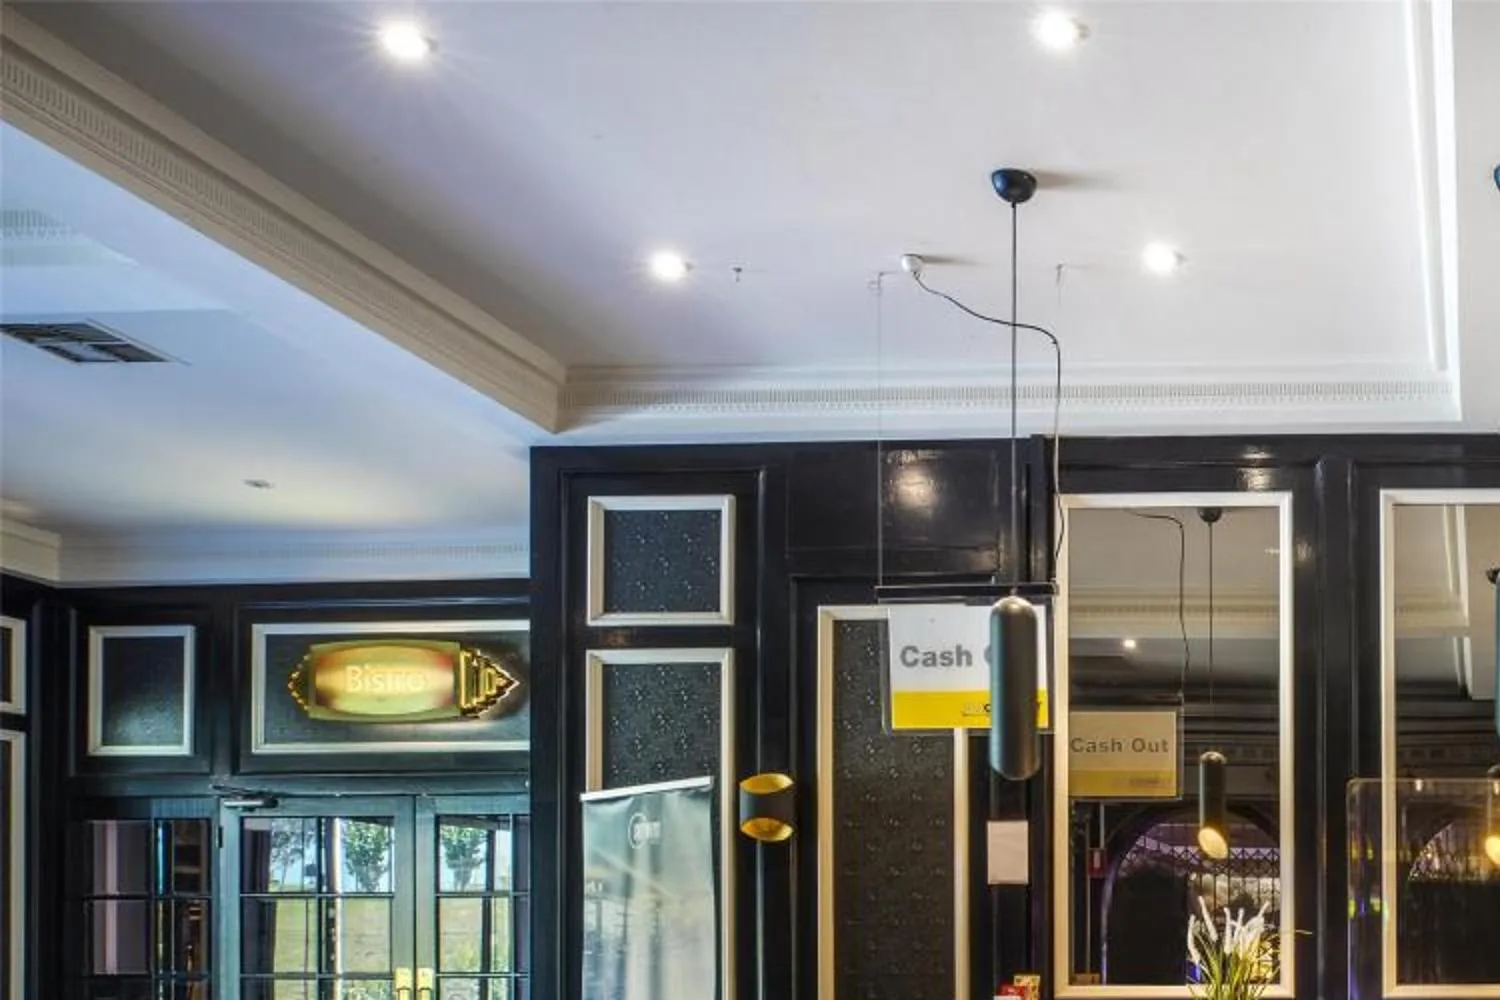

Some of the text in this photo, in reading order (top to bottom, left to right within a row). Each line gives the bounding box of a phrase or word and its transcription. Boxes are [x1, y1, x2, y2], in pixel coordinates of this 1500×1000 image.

[900, 644, 973, 668] Cash
[345, 664, 428, 693] Bistro
[1071, 737, 1169, 753] Cash Out
